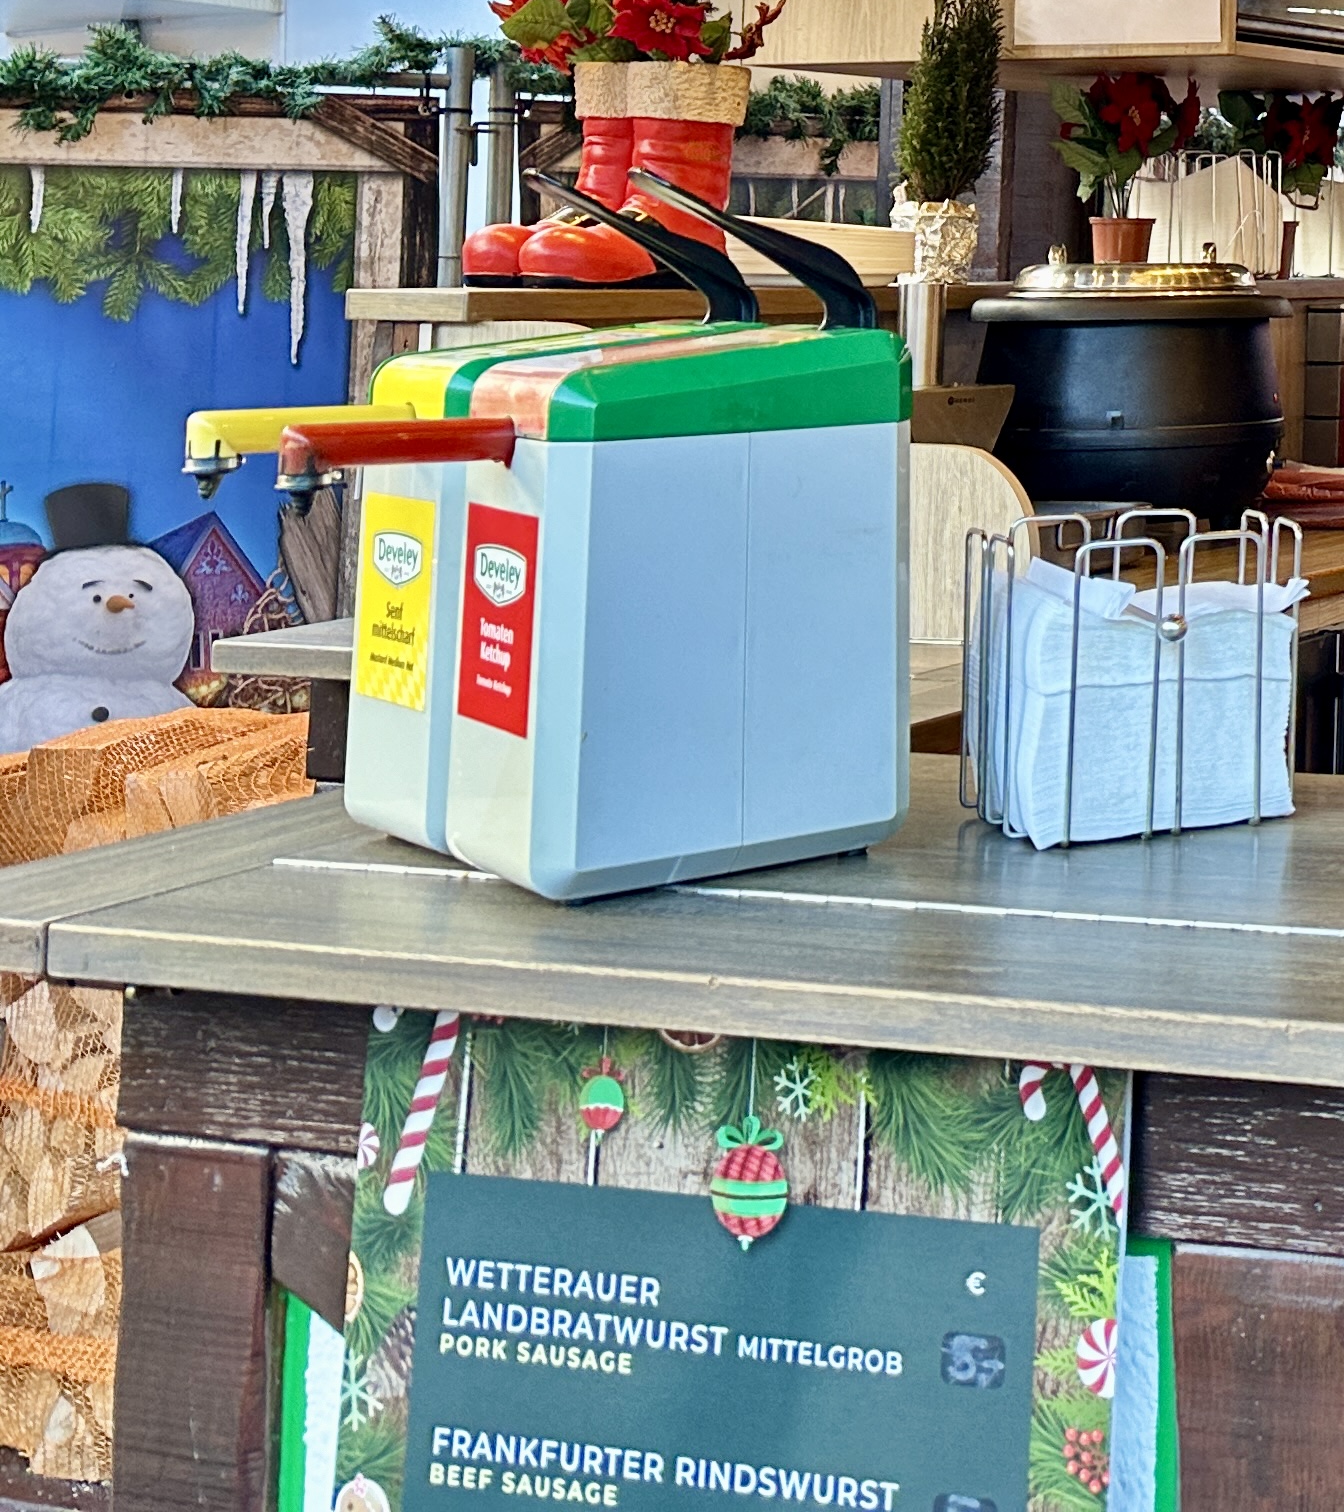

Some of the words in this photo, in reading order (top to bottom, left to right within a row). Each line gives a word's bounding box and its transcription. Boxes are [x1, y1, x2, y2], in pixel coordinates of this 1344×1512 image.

[378, 537, 419, 572] Develey
[480, 551, 522, 591] Develey
[386, 601, 404, 621] Senf
[480, 617, 514, 645] Tomaten
[371, 621, 416, 647] mittelscharf
[480, 641, 511, 672] Ketchup
[446, 1256, 660, 1307] WETTERAUER
[965, 1271, 987, 1297] €
[439, 1333, 507, 1360] PORK
[516, 1341, 633, 1375] SAUSAGE
[442, 1297, 729, 1356] LANDBRATWURST
[737, 1335, 903, 1376] MITTELGROB
[429, 1463, 493, 1489] BEEF
[501, 1471, 618, 1506] SAUSAGE
[432, 1426, 665, 1483] FRANKFURTER
[675, 1455, 900, 1512] RINDSWURST
